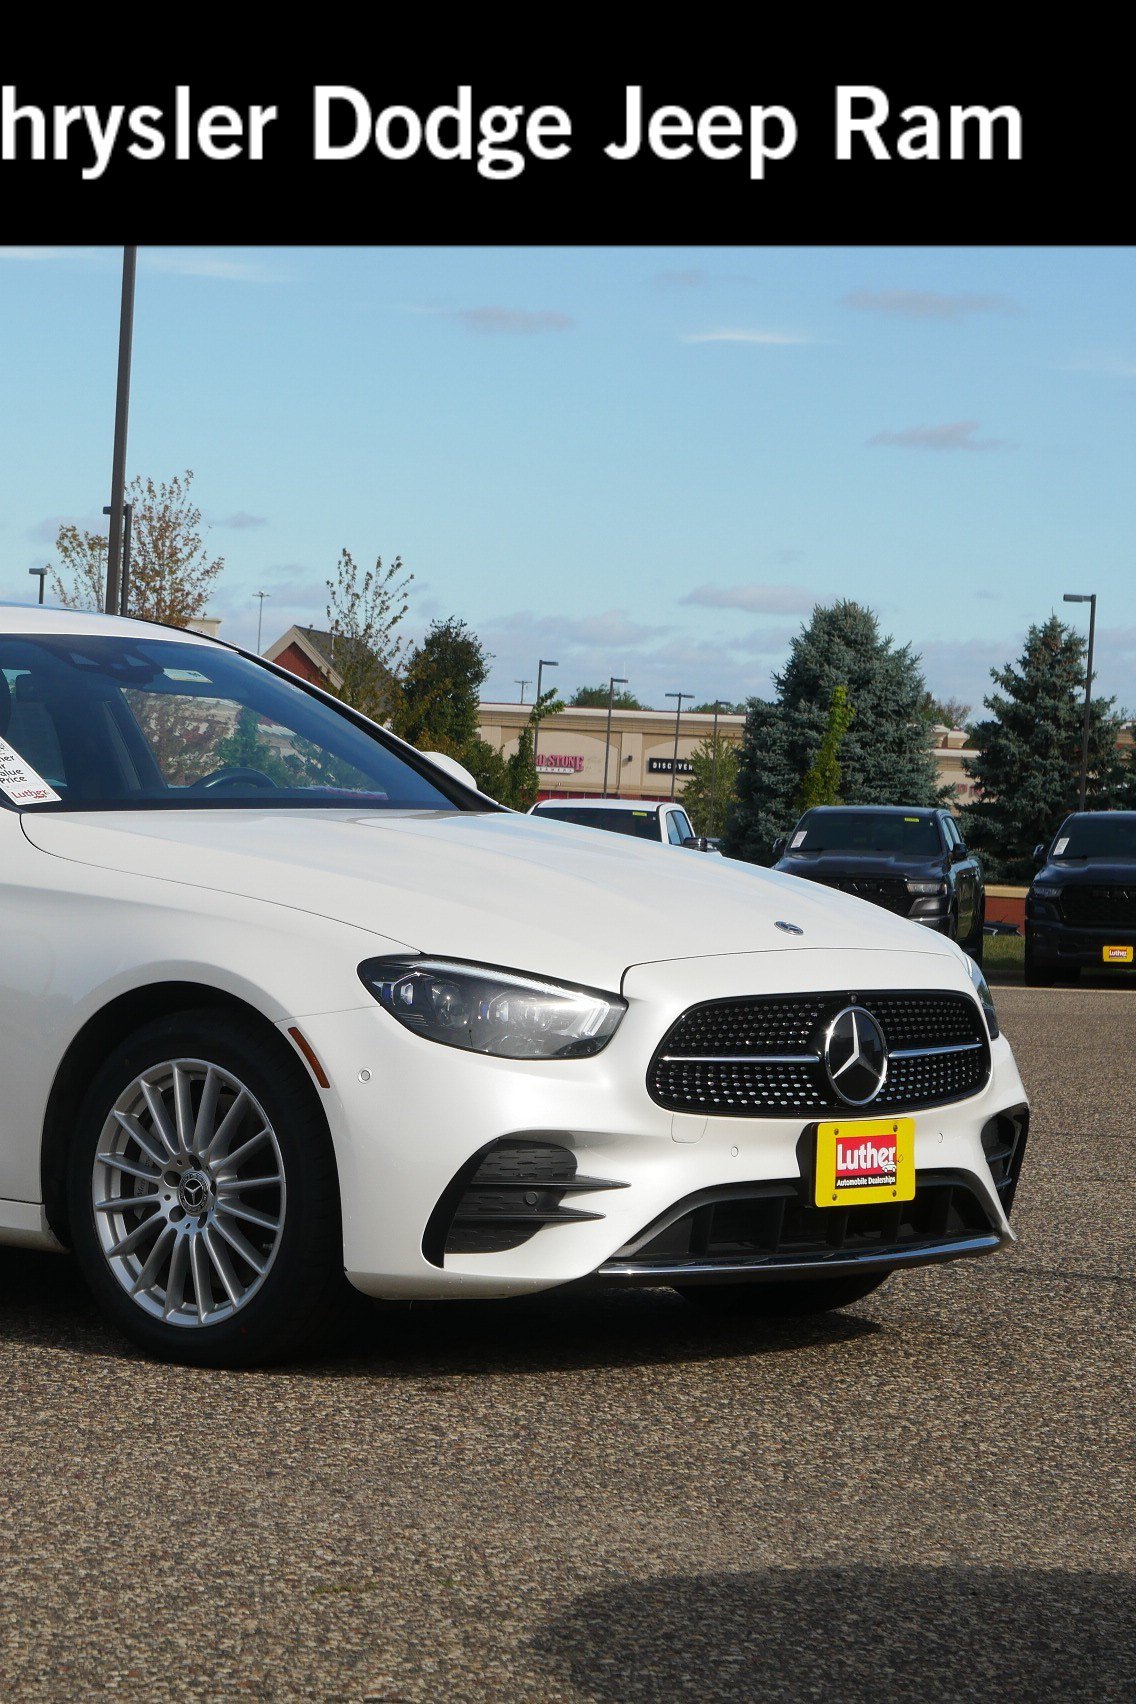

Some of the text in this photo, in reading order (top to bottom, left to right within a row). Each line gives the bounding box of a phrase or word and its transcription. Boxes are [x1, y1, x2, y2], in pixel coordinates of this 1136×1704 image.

[10, 789, 47, 799] Luther
[836, 1141, 897, 1171] Luther
[836, 1175, 896, 1187] Automobile Dealerships
